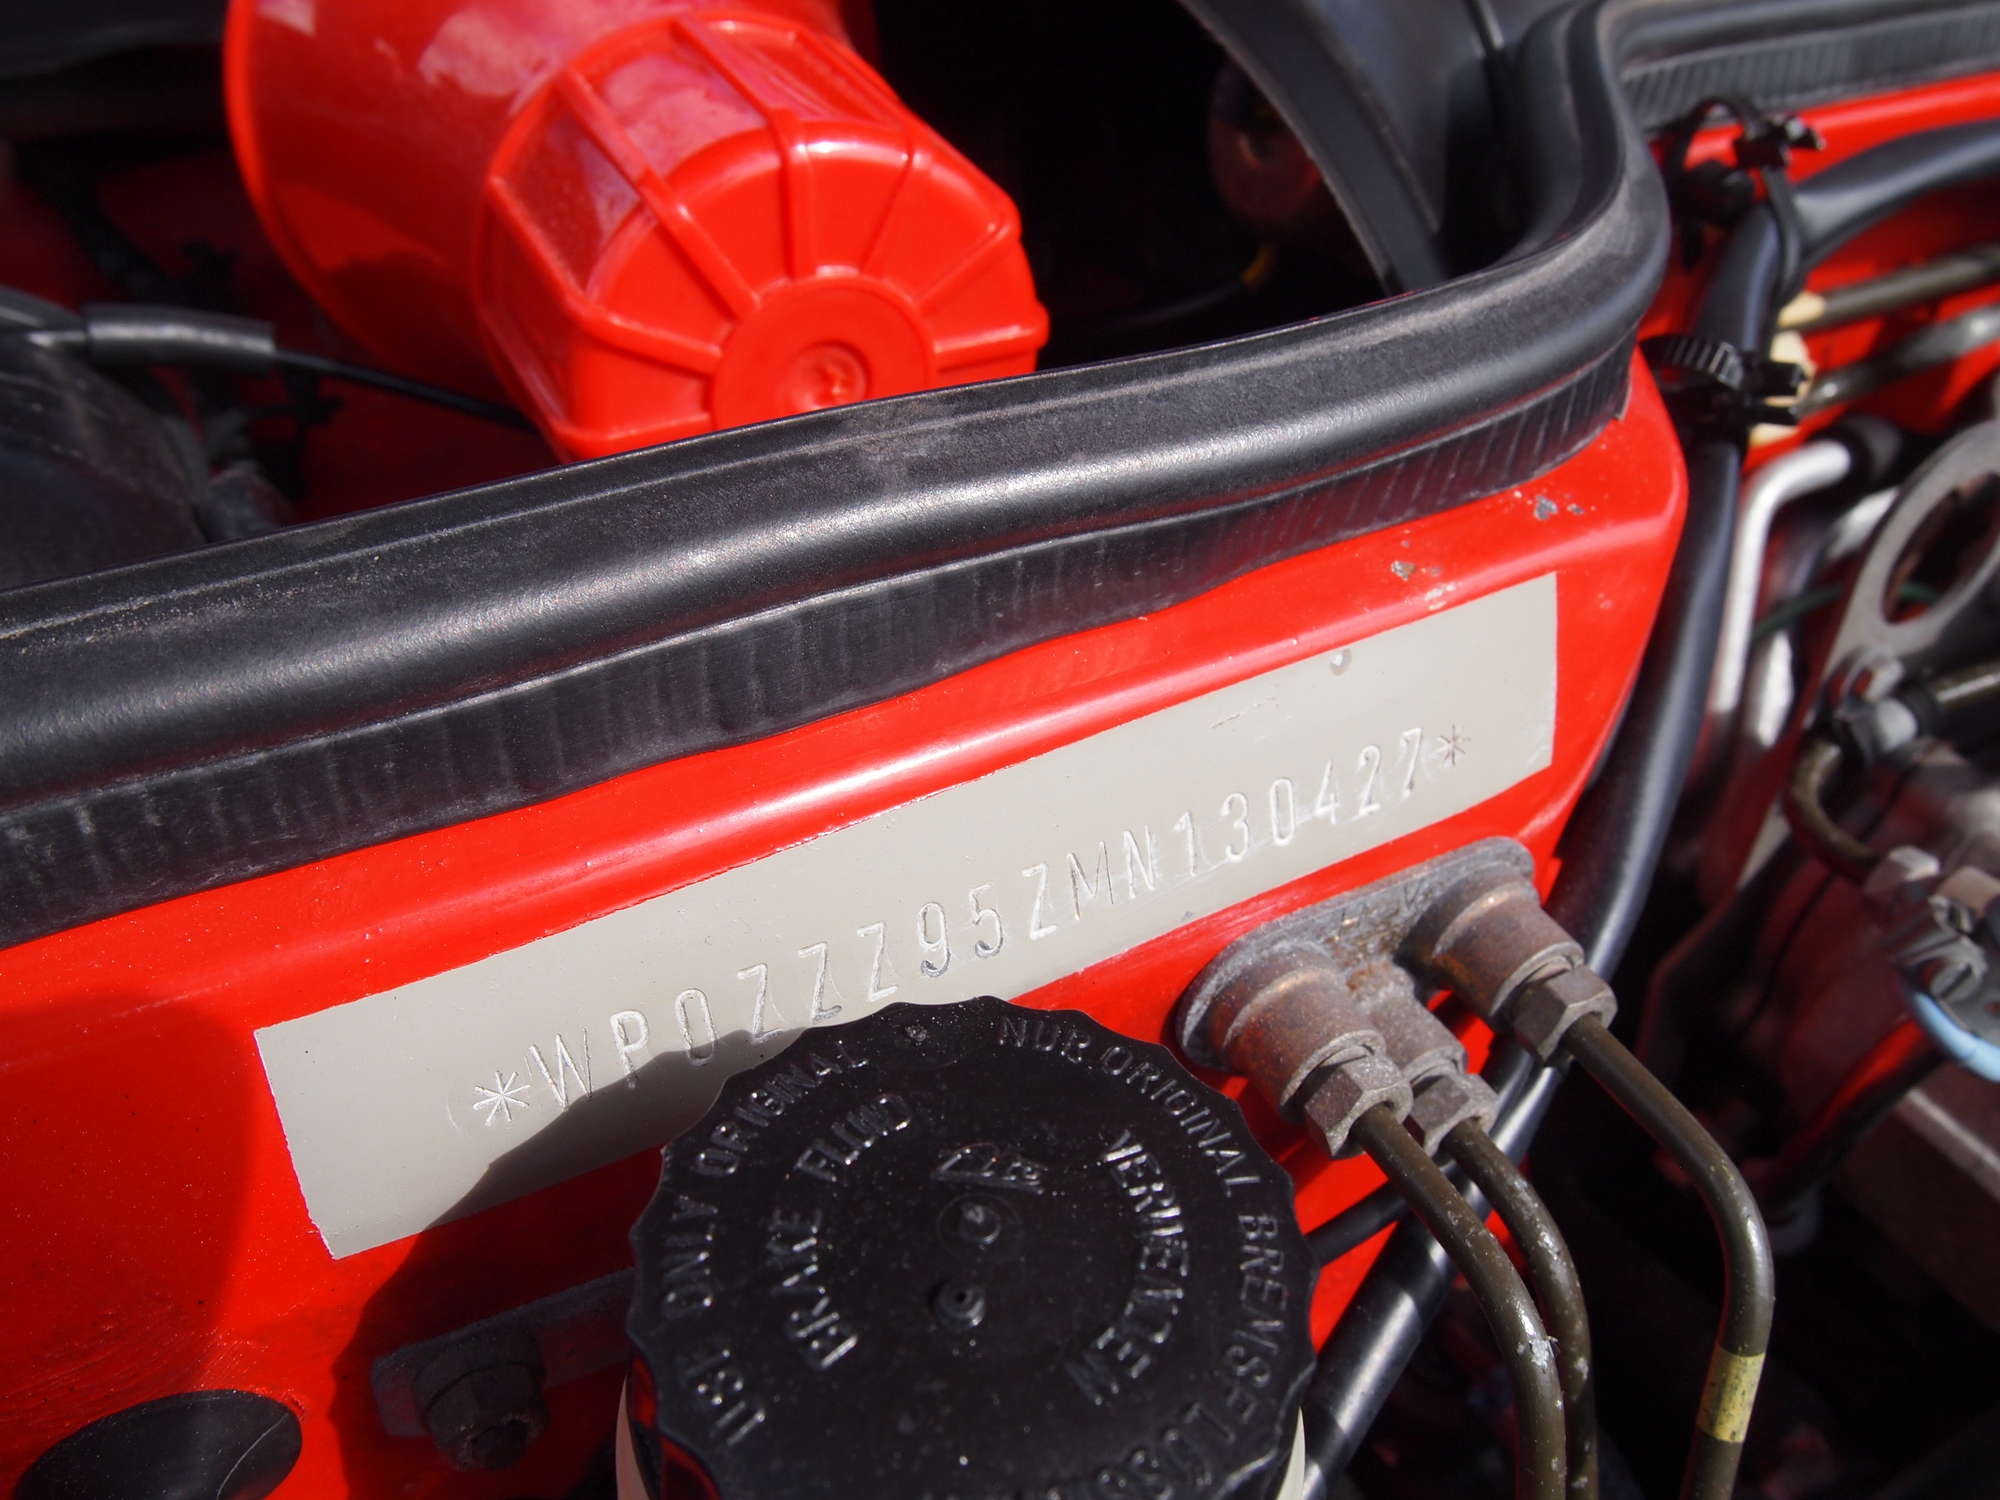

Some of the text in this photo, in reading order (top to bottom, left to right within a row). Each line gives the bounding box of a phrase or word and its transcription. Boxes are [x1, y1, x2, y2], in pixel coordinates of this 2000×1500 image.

[661, 1040, 870, 1450] USE ONLY ORIGINAL
[764, 1093, 913, 1371] BRAKE FLUID
[999, 1016, 1092, 1064] NUR
[1099, 1045, 1261, 1199] ORIGINAL
[1062, 1128, 1190, 1404] VERWENDEN
